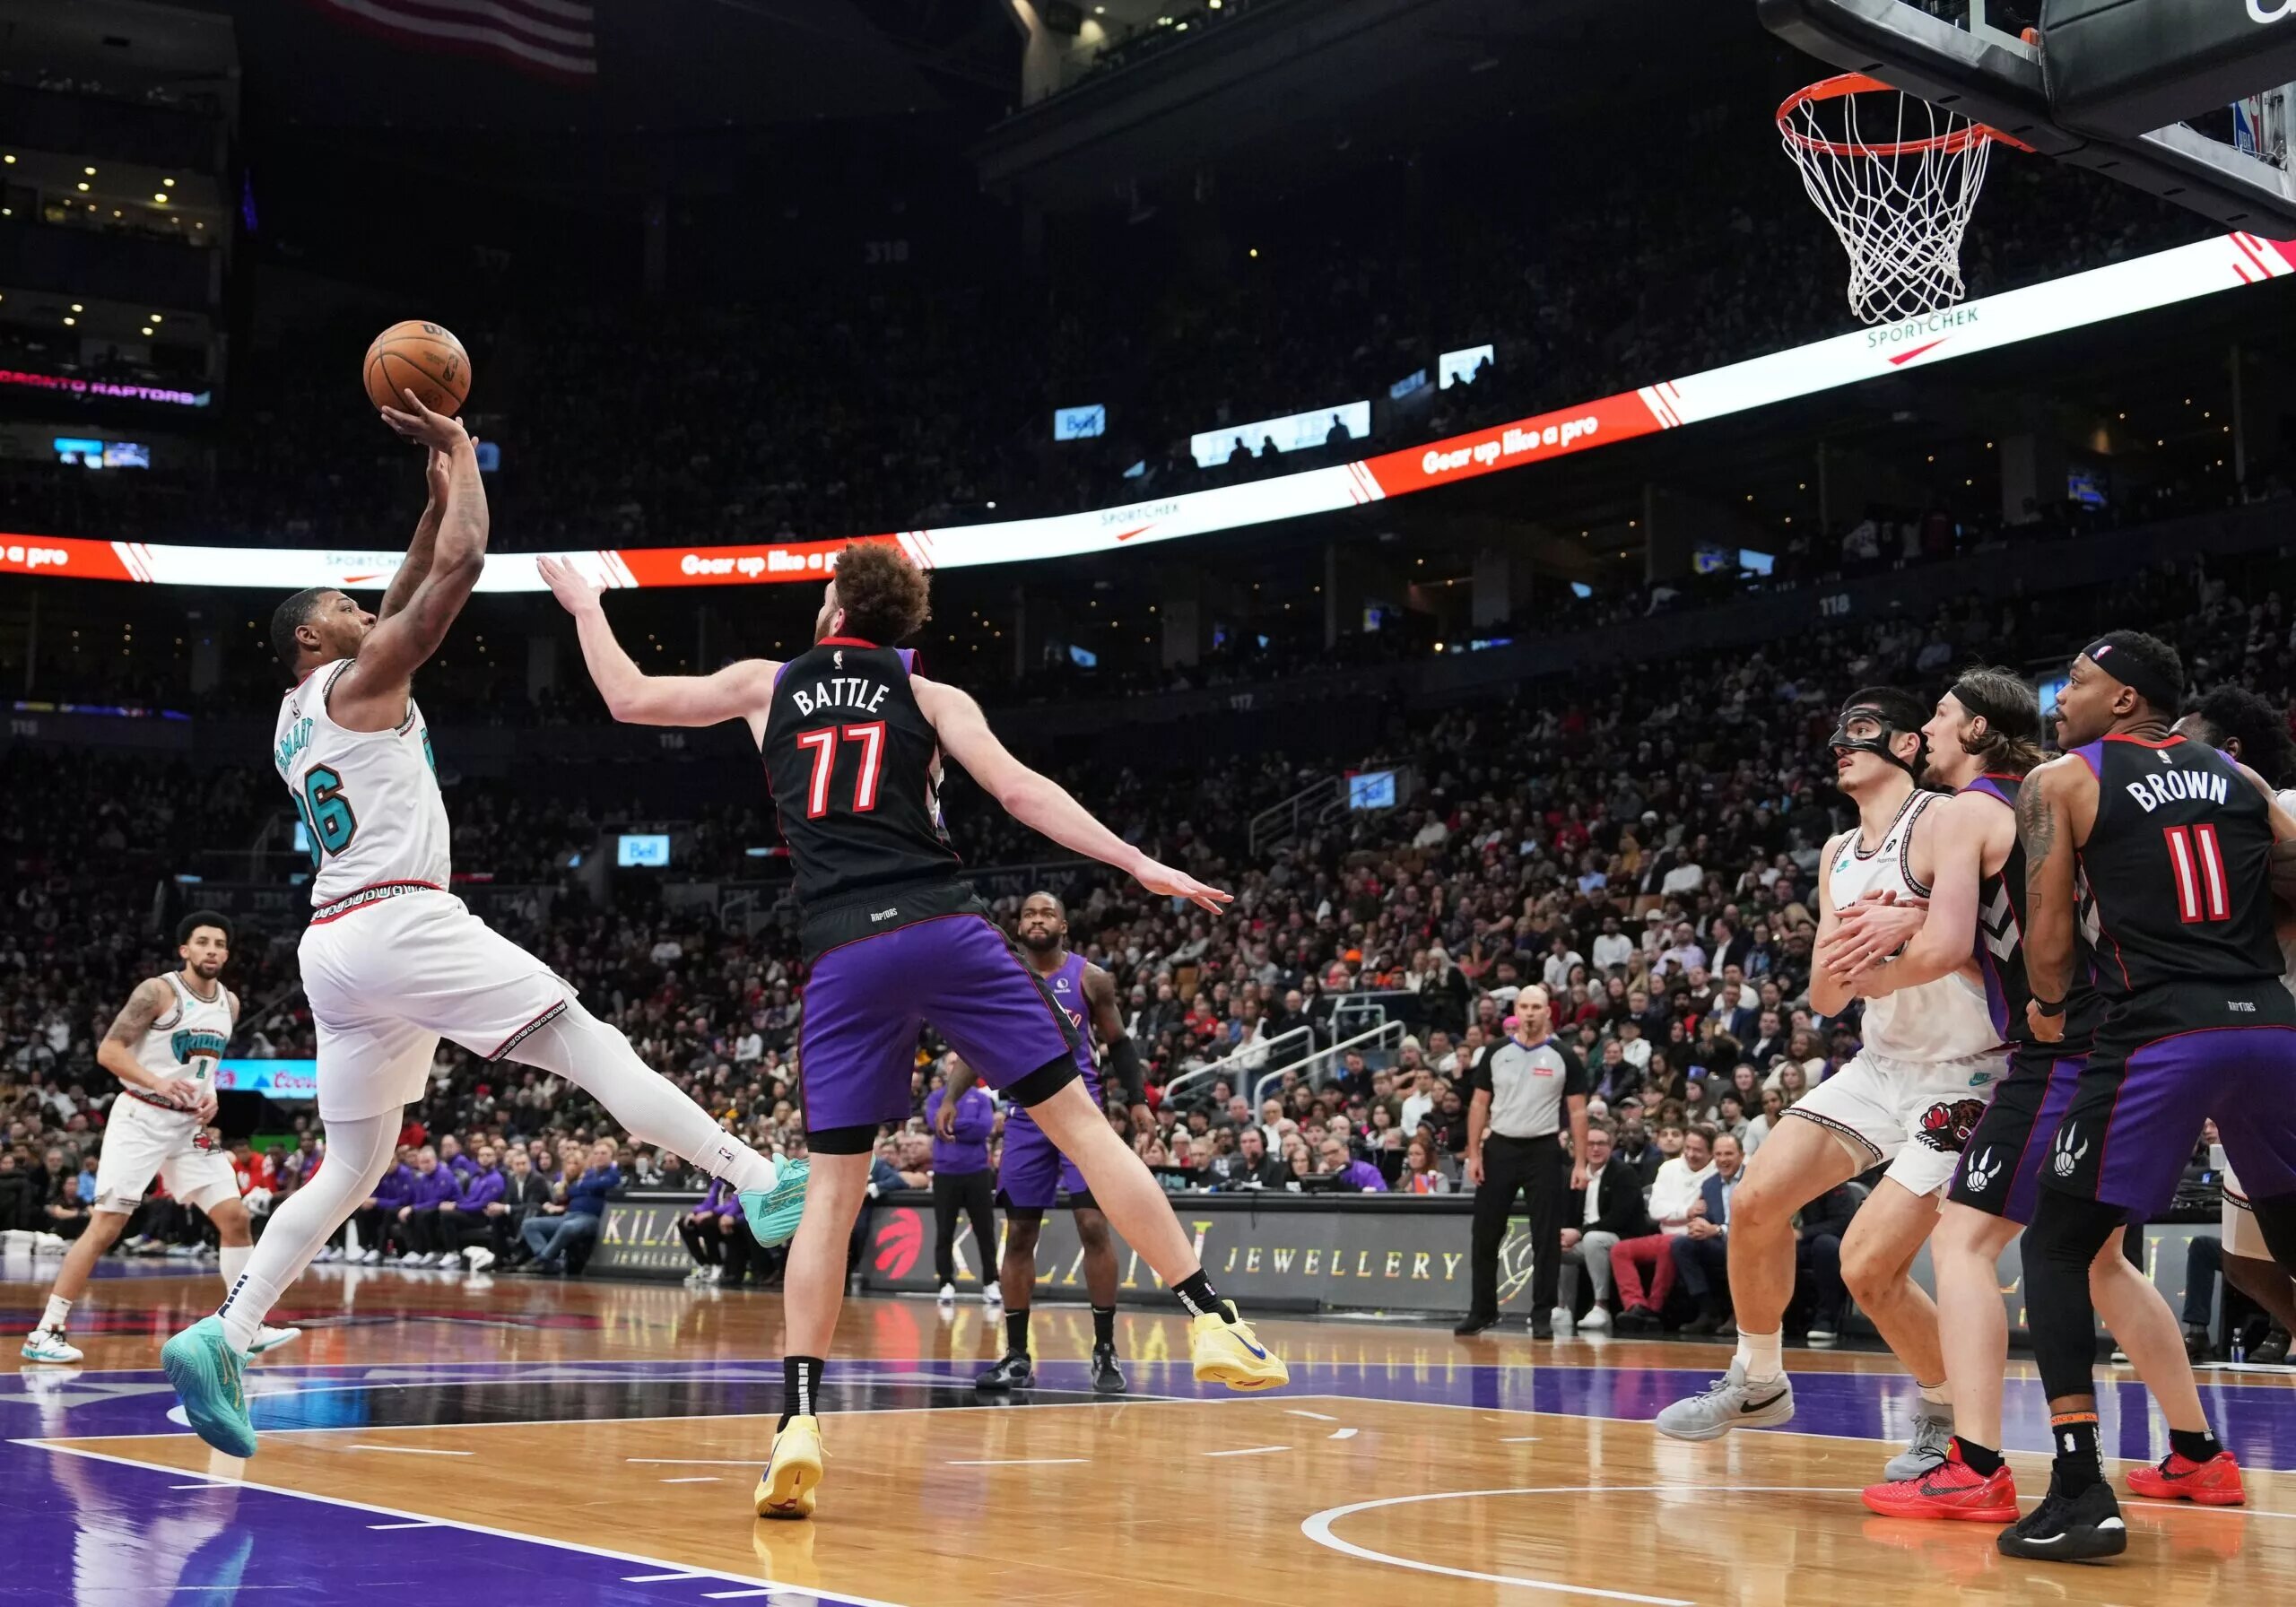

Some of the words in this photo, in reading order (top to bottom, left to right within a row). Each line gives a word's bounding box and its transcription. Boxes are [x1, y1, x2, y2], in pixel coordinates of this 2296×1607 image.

[1868, 308, 1979, 348] SPORTCHEK
[91, 382, 194, 404] RAPTORS
[1422, 451, 1472, 474] Gear
[1474, 441, 1500, 465] up
[1502, 428, 1540, 455] like
[1543, 426, 1558, 445] a
[1561, 416, 1598, 447] pro
[7, 546, 25, 562] a
[27, 547, 68, 569] pro
[682, 554, 735, 575] Gear
[737, 548, 766, 578] up
[768, 541, 805, 571] like
[808, 553, 822, 569] a
[1819, 594, 1850, 617] 118
[792, 677, 890, 717] BATTLE
[275, 717, 314, 776] SMART
[797, 720, 886, 820] 77
[2126, 769, 2228, 813] BROWN
[2162, 823, 2231, 924] 11
[871, 908, 898, 923] RAPTORS
[196, 1059, 207, 1079] 1
[1224, 1247, 1463, 1280] JEWELLERY
